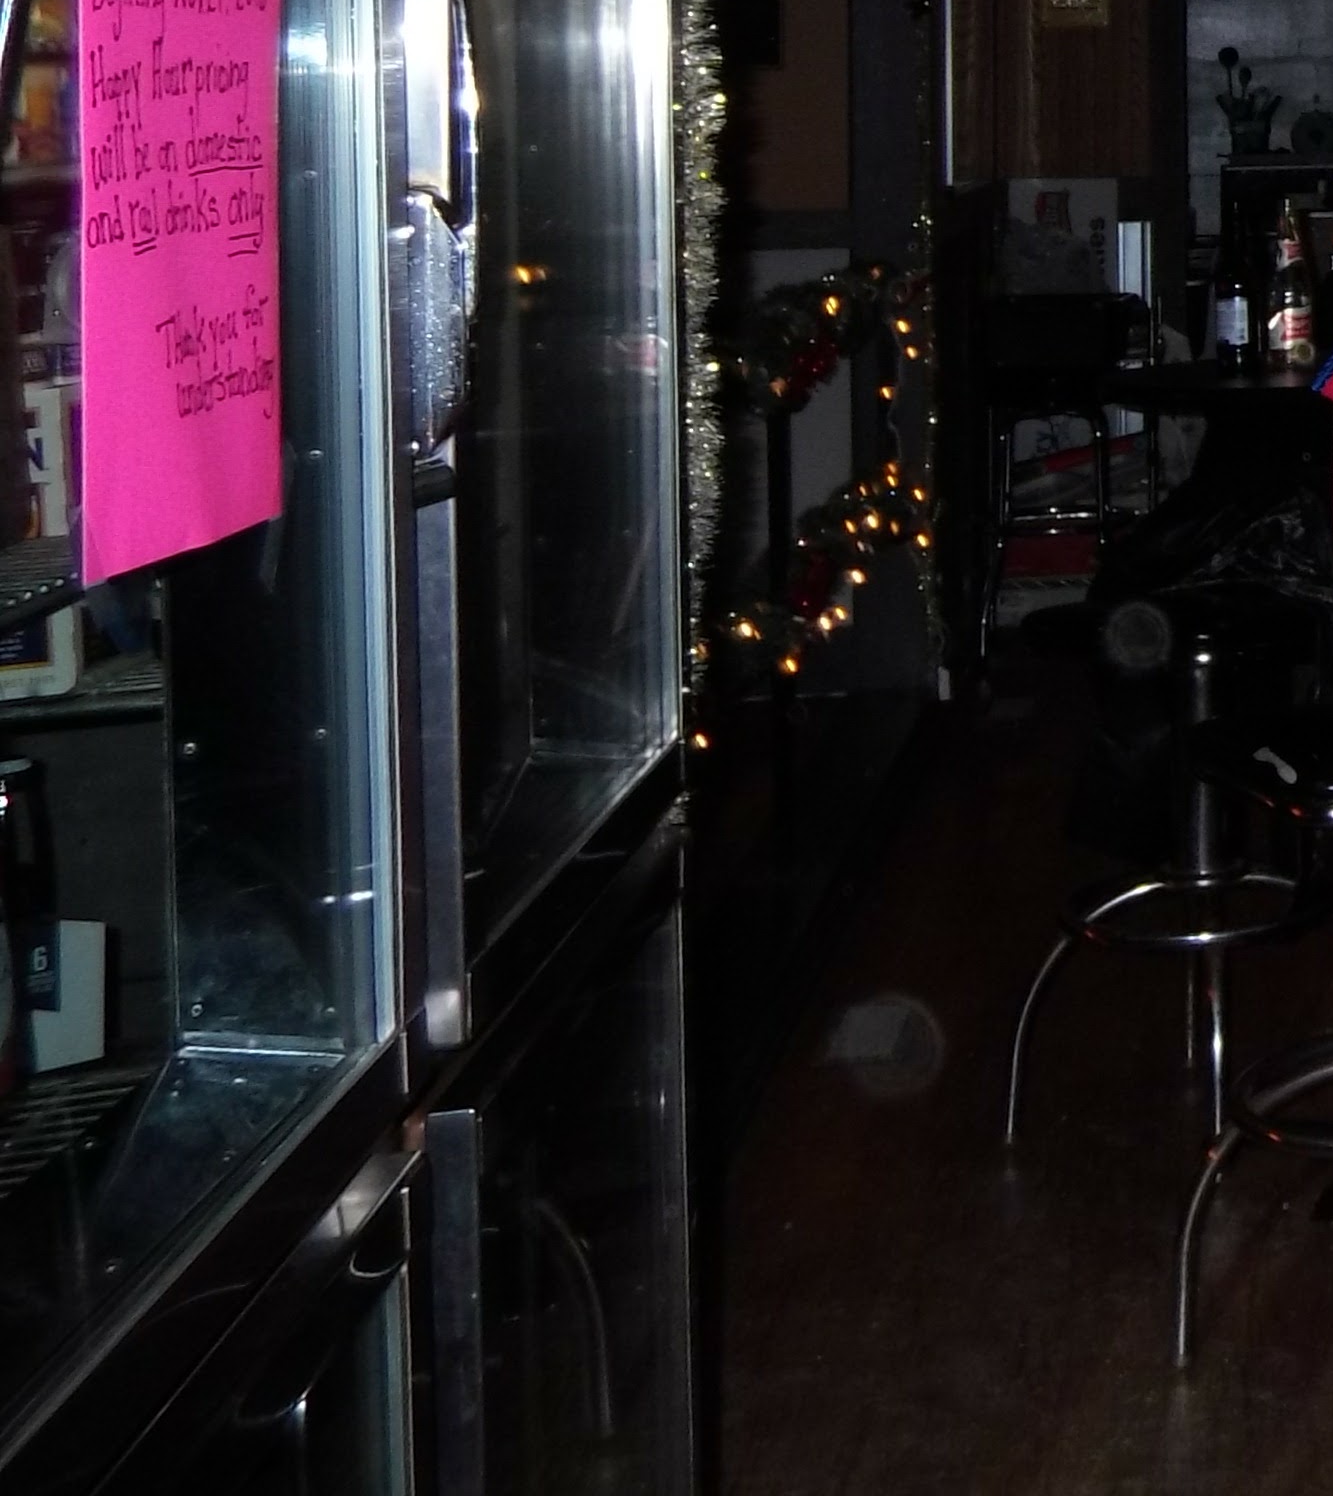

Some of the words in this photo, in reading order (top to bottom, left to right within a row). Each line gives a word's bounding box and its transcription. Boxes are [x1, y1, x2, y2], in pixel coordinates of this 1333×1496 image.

[90, 45, 142, 130] Happy
[152, 43, 194, 100] Hour
[90, 124, 127, 190] will
[131, 123, 151, 180] be
[159, 141, 178, 172] on
[185, 106, 262, 170] domestic
[87, 195, 124, 248] and
[165, 177, 221, 236] drinks
[228, 172, 264, 249] only
[155, 305, 207, 370] Thank
[209, 311, 238, 371] you
[243, 284, 269, 330] for
